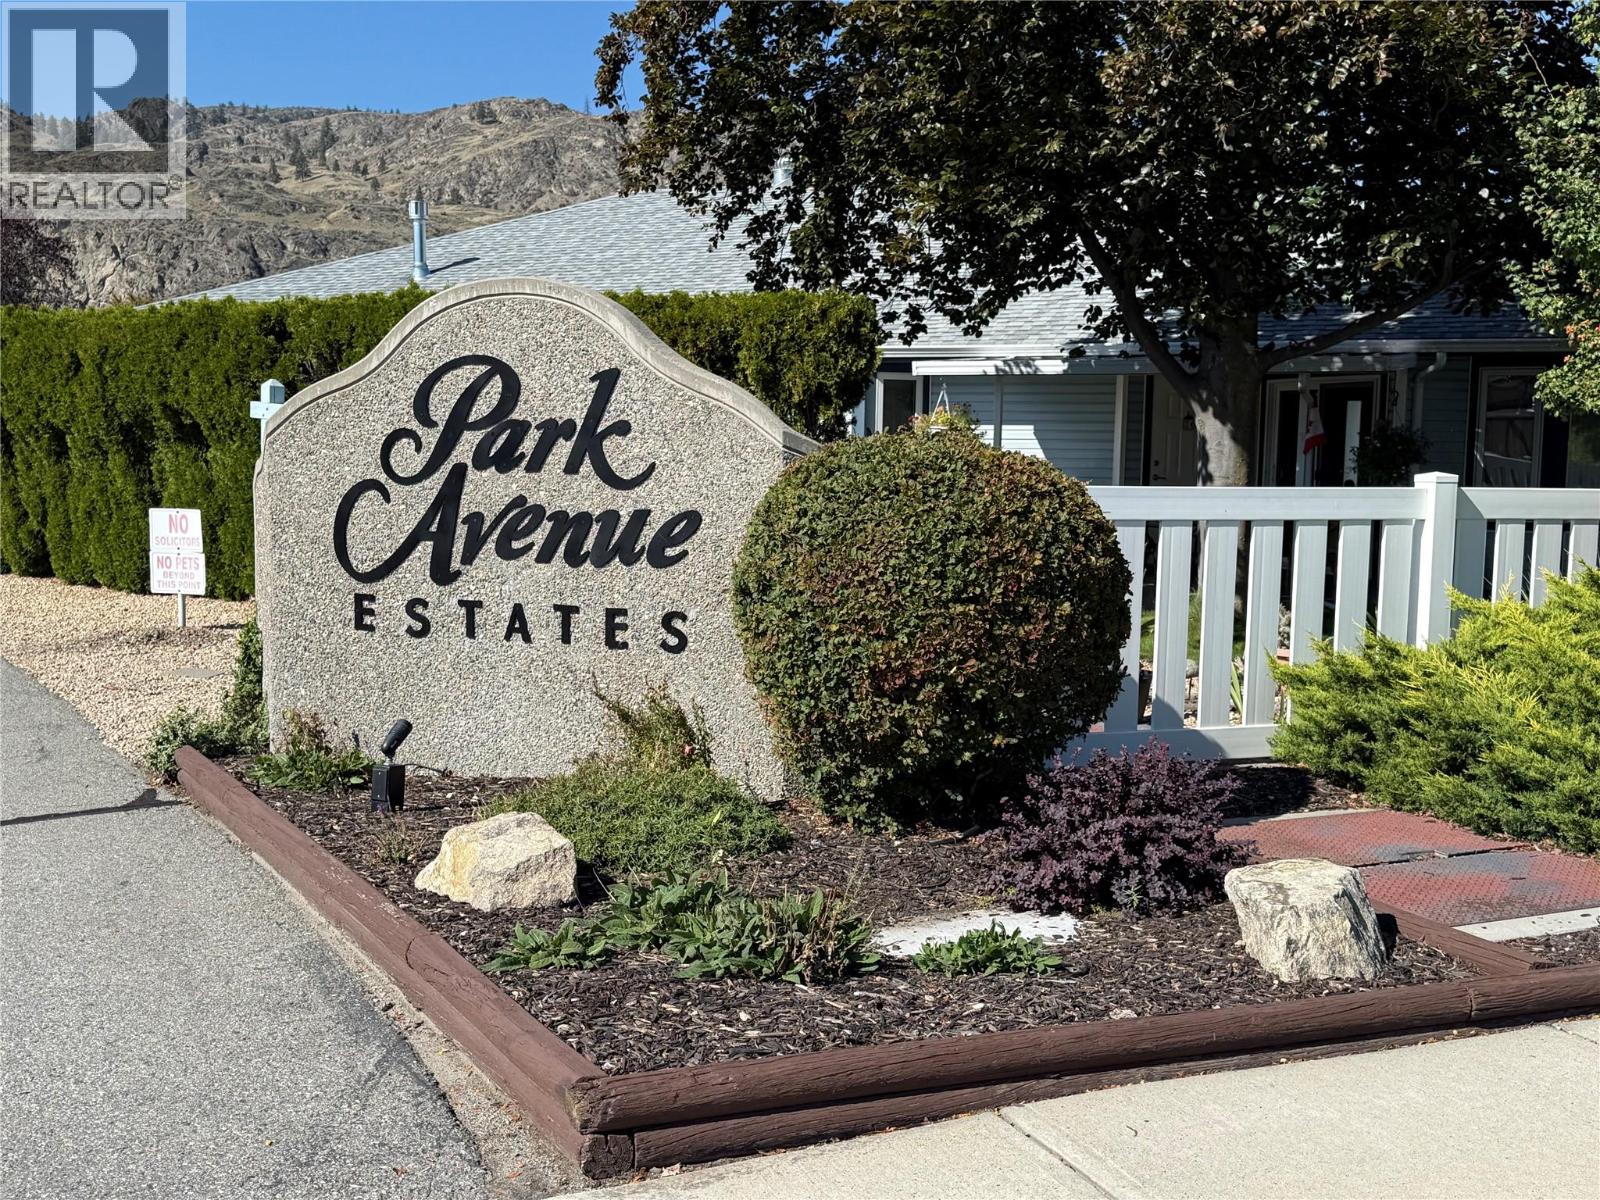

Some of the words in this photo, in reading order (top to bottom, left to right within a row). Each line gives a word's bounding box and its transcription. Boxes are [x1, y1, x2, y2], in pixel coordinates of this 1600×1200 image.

[380, 354, 656, 491] Park
[168, 513, 188, 534] NO
[333, 462, 702, 587] Avenue
[154, 536, 200, 547] SOLICITORS
[156, 555, 172, 569] NO
[175, 556, 200, 570] PETS
[162, 571, 195, 580] BEYOND
[157, 580, 176, 589] THIS
[178, 581, 201, 590] POINT
[354, 593, 688, 654] ESTATES
